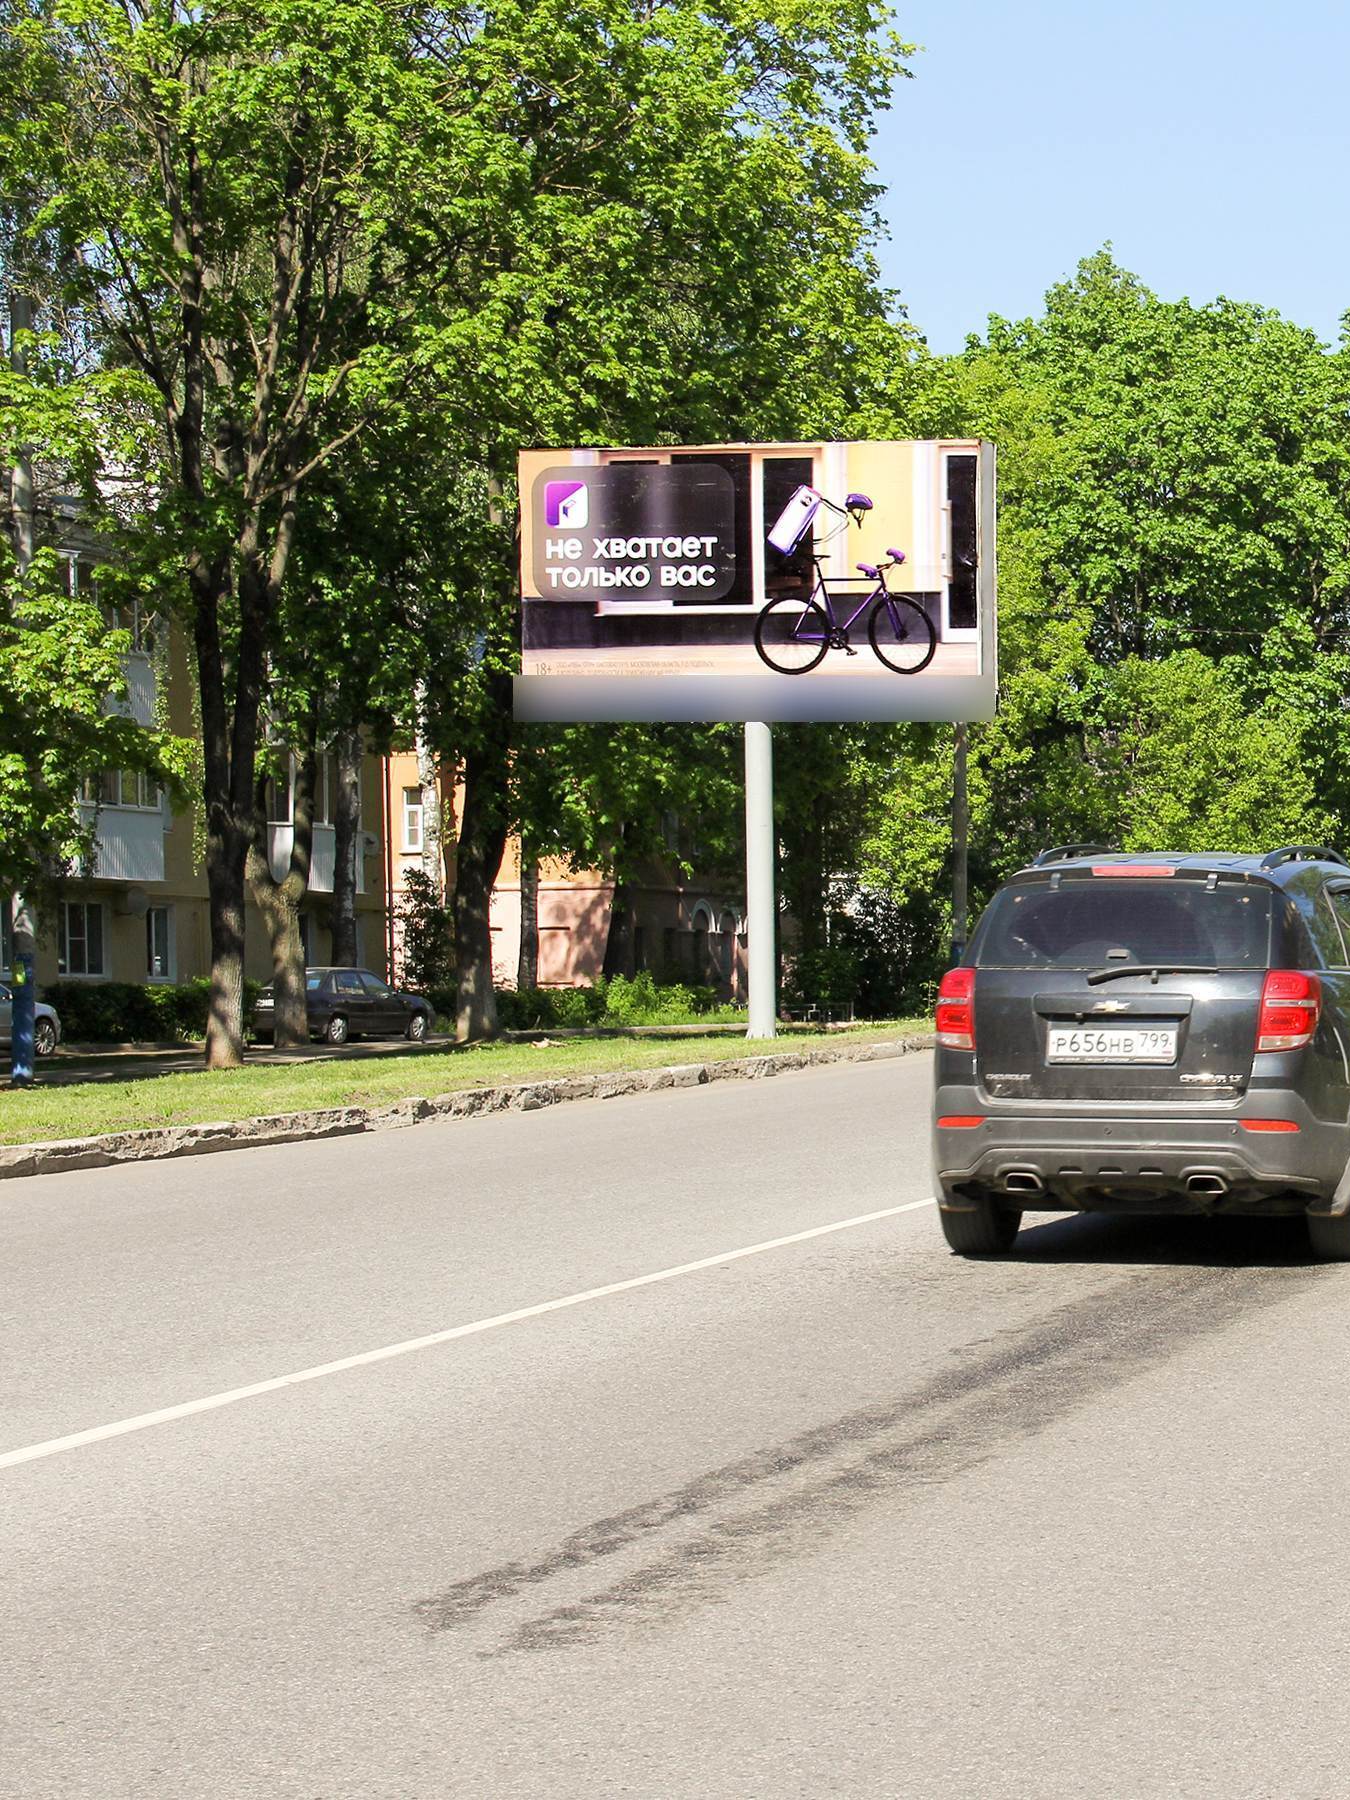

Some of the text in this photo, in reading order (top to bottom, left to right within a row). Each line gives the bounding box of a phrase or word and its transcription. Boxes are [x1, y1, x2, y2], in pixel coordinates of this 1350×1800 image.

[545, 536, 718, 560] не хватает
[545, 564, 716, 588] только вас
[536, 663, 552, 675] 18+
[1139, 1033, 1170, 1048] 799
